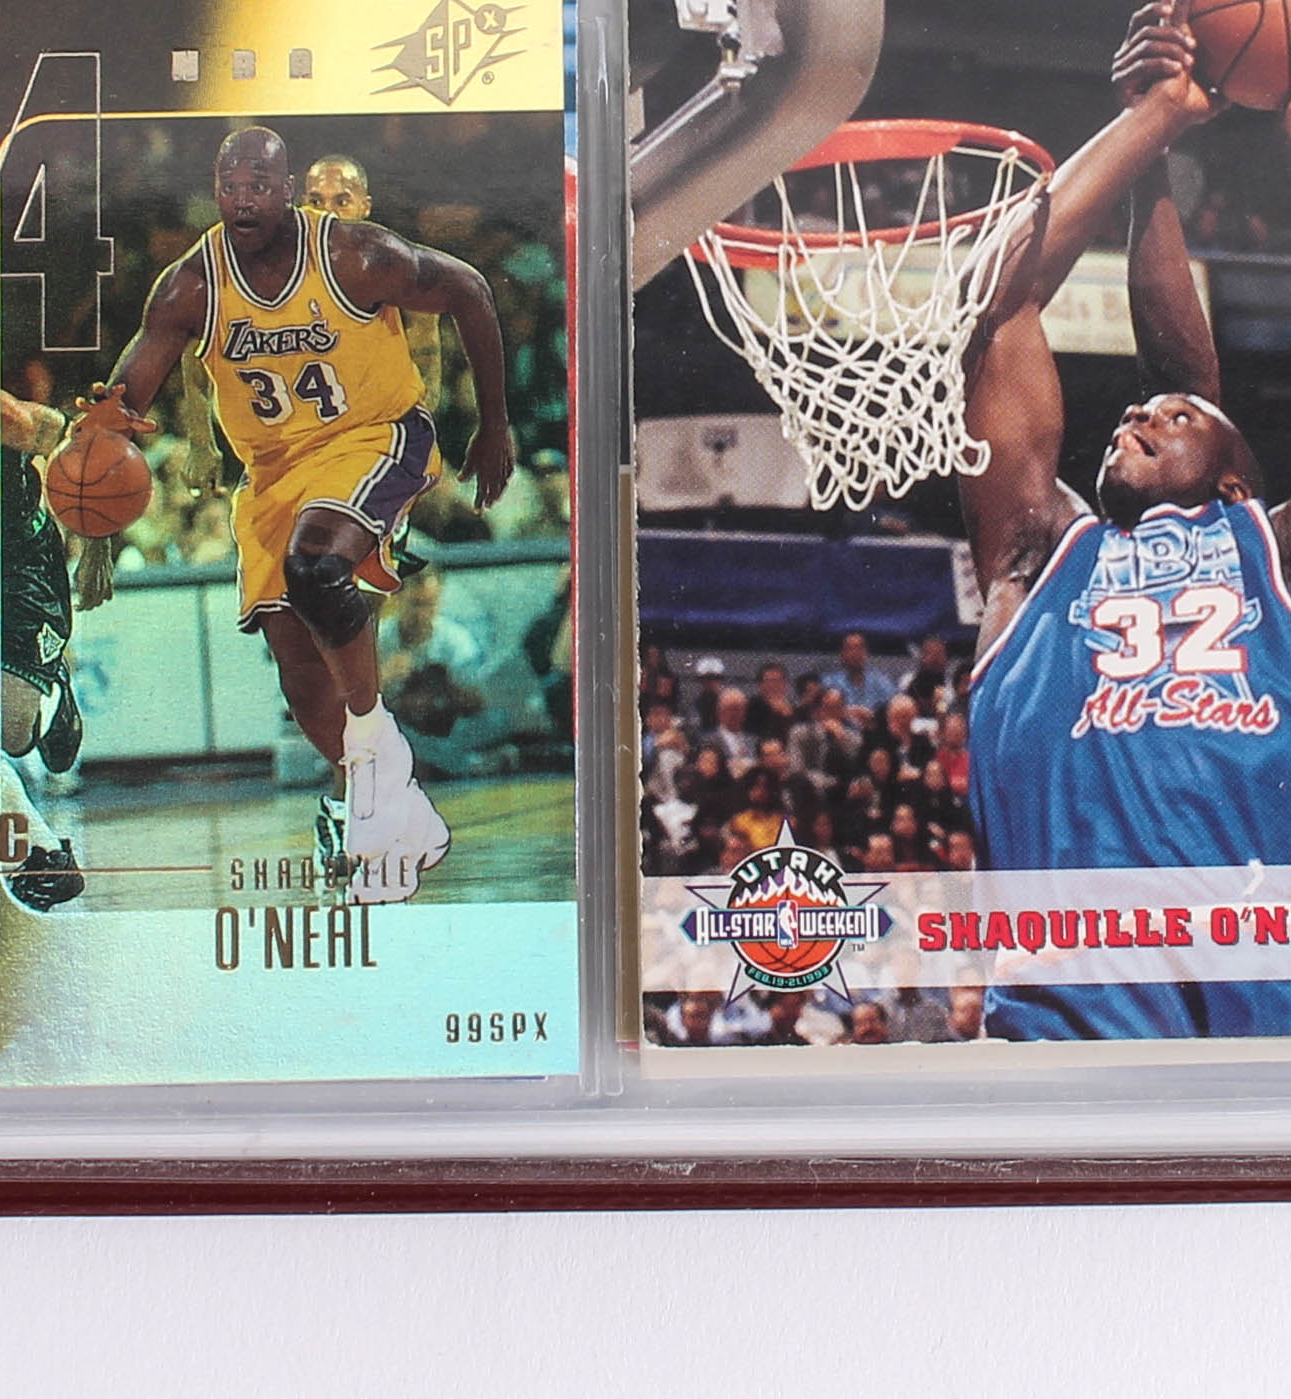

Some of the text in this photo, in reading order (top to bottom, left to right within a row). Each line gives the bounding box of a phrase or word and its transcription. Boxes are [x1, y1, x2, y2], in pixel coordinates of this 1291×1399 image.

[222, 317, 341, 364] LAKERS
[235, 359, 350, 427] 34
[1090, 584, 1249, 681] 32
[1071, 677, 1281, 739] All-Stars
[737, 850, 837, 885] UTAH
[214, 905, 378, 971] O'NEAL
[799, 903, 880, 943] WEEKEND
[917, 907, 1193, 953] SHAQUILLE
[445, 1011, 549, 1043] 99SPX
